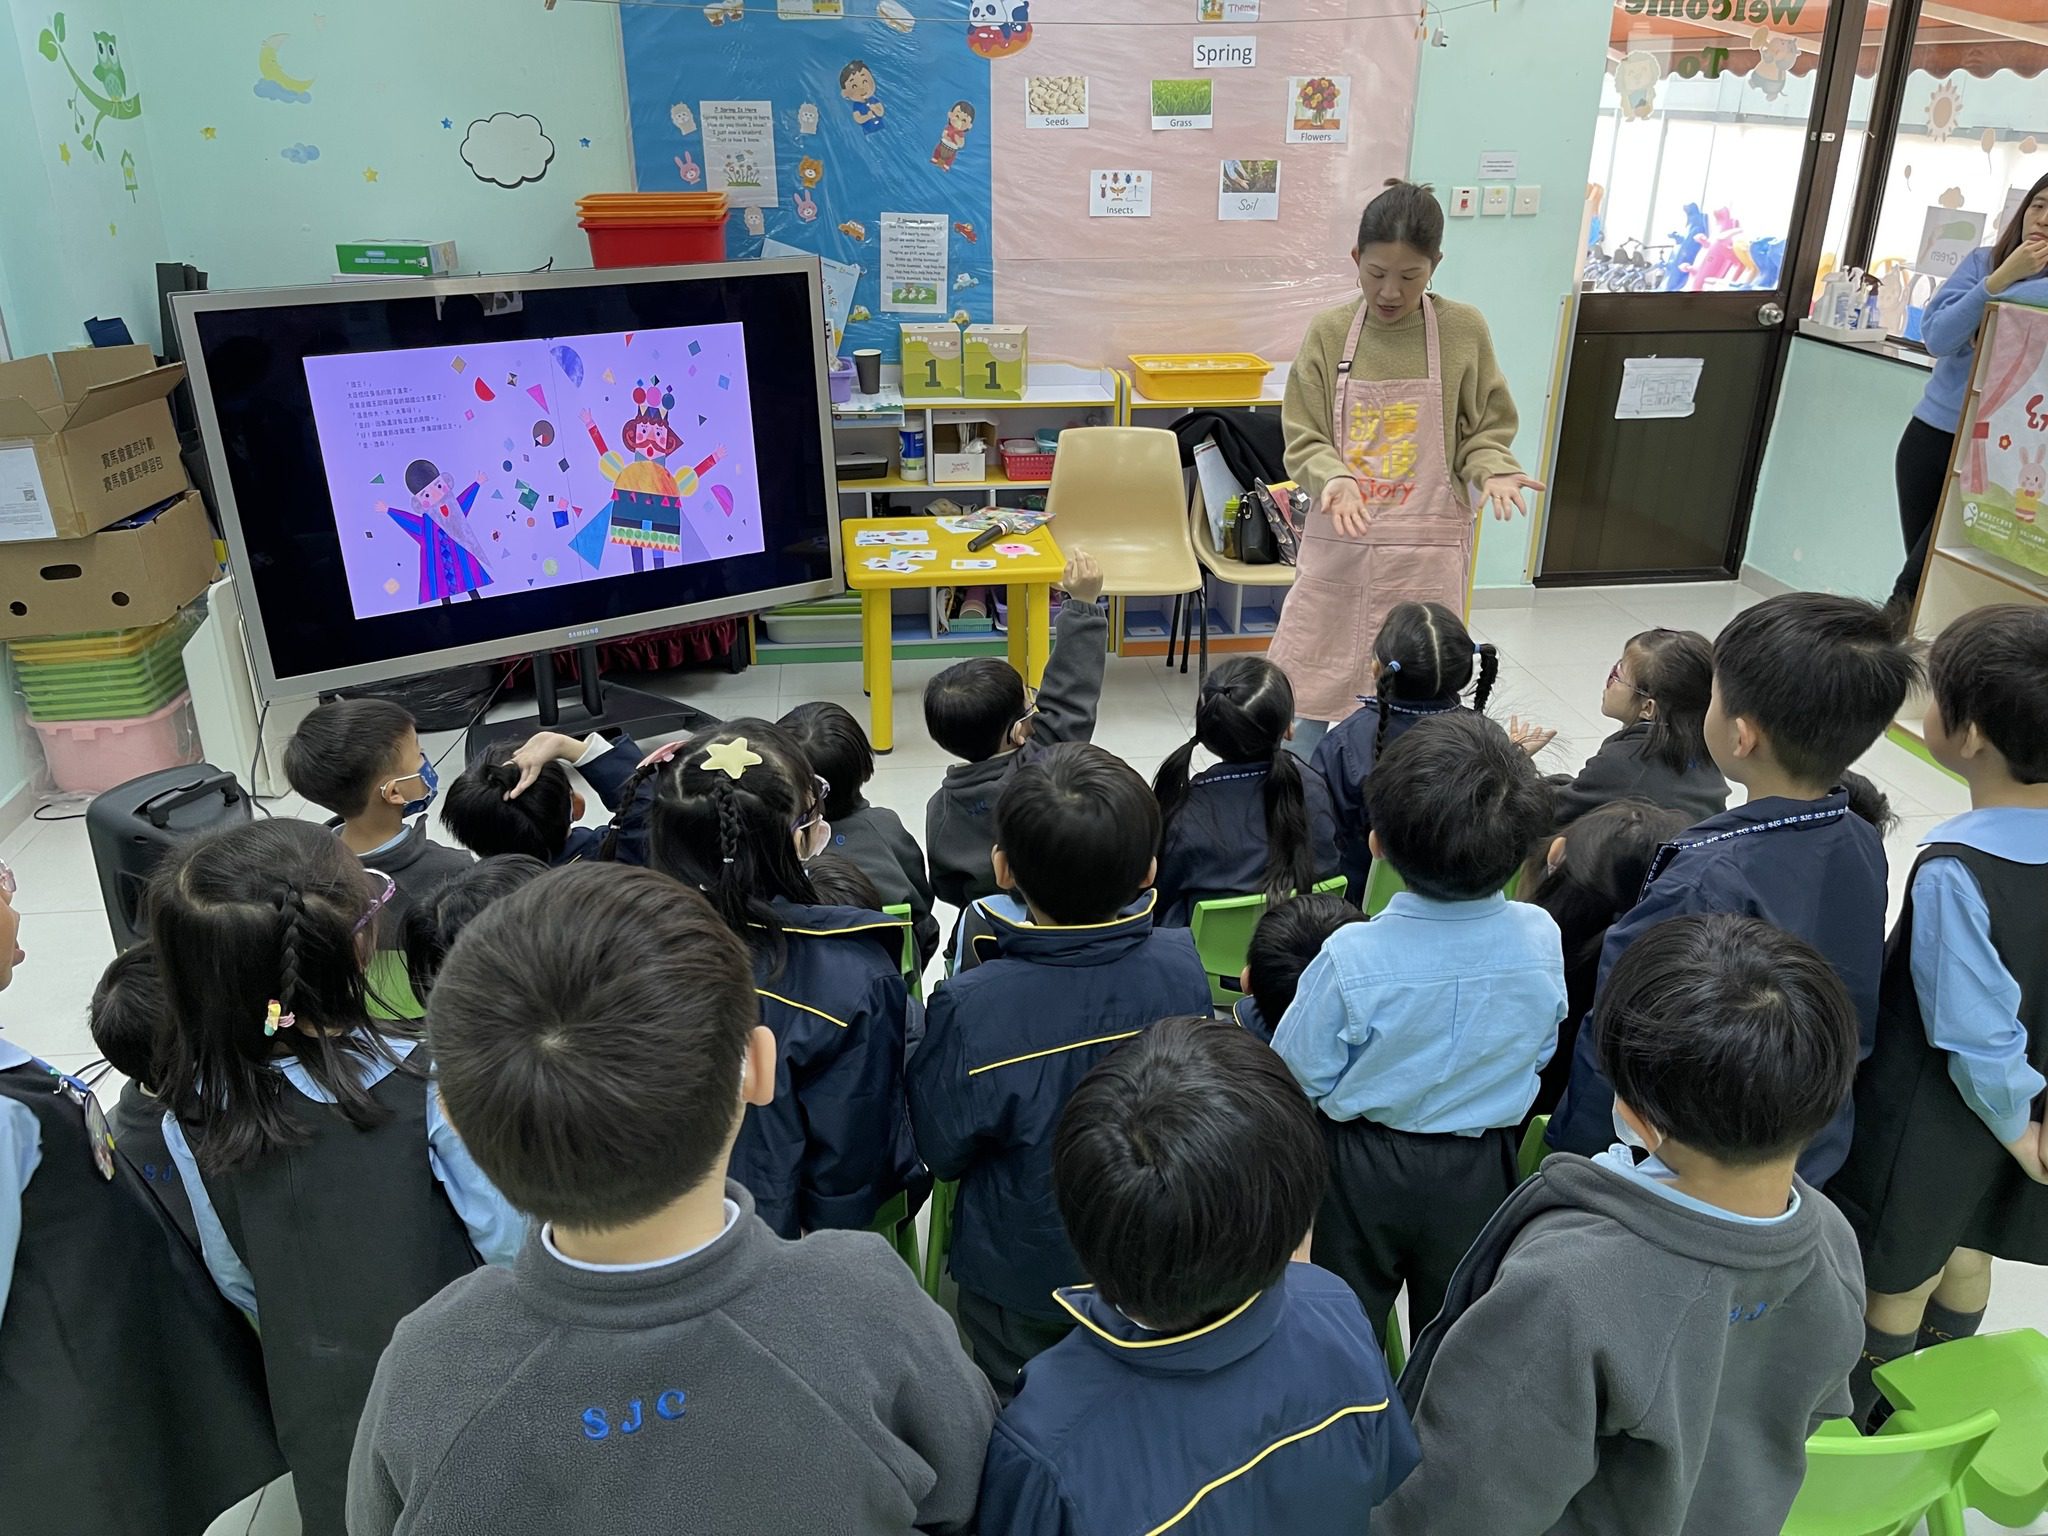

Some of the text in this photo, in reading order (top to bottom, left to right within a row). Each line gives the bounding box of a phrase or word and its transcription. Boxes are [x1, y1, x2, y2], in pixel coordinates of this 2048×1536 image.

[1227, 3, 1256, 13] Theme
[1197, 44, 1253, 66] Spring
[1045, 117, 1070, 127] Seeds
[1170, 118, 1193, 127] Grass
[1300, 132, 1332, 141] Flowers
[1106, 206, 1134, 215] Insects
[1238, 198, 1259, 211] Soil
[925, 359, 941, 388] 1
[984, 361, 1001, 389] 1
[568, 627, 599, 639] SAMSUNG
[582, 1390, 687, 1440] SJC
